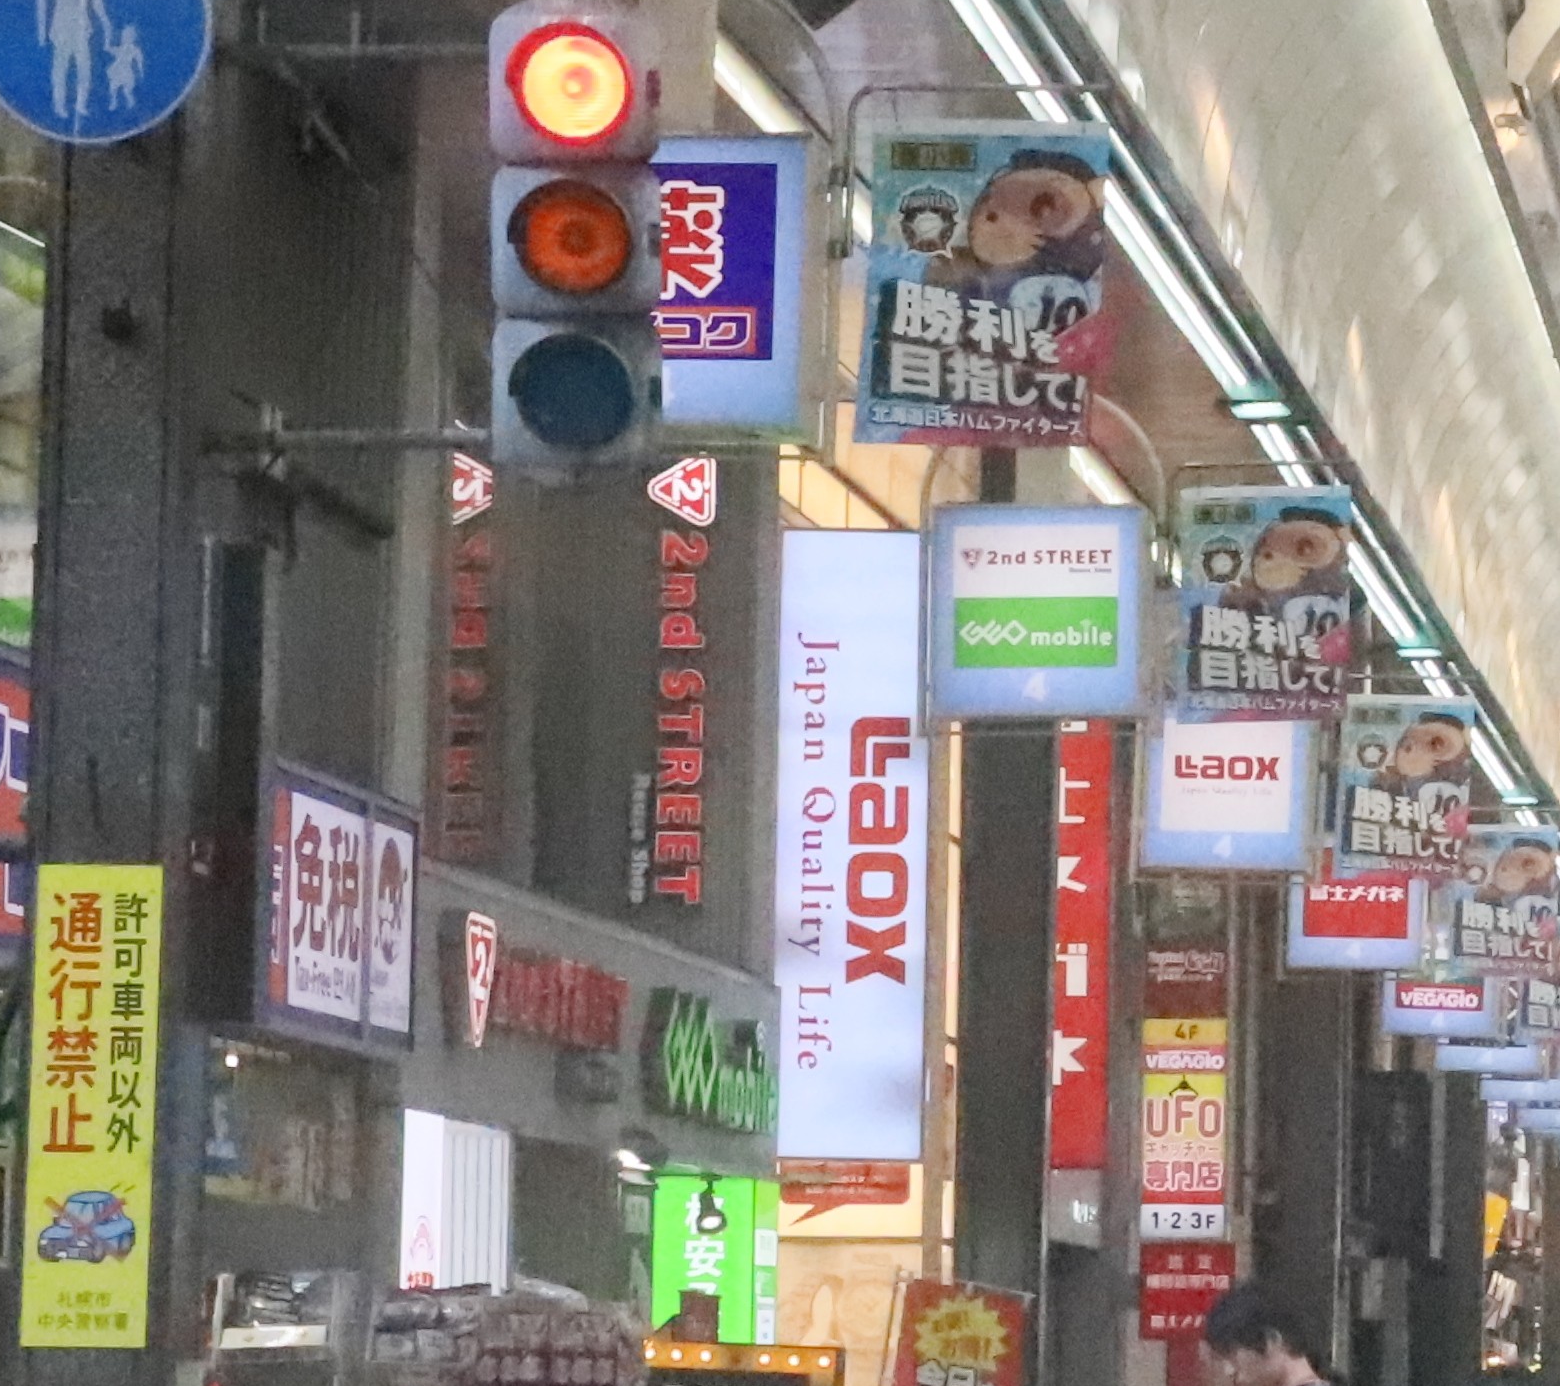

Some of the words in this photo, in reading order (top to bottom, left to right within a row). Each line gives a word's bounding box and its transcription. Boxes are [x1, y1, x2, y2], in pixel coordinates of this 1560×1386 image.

[892, 281, 1060, 364] 勝利を
[889, 344, 1087, 413] 目指して!
[660, 529, 709, 649] 2nd
[986, 547, 1027, 565] 2nd
[1034, 547, 1112, 565] STREET
[1031, 618, 1112, 647] mobile
[1200, 605, 1322, 659] 勝利を
[792, 631, 840, 763] Japan
[1200, 652, 1342, 694] 目指して!
[654, 667, 705, 904] STREET
[791, 785, 838, 958] Quality
[1350, 823, 1462, 859] 目指して!
[293, 812, 360, 962] 免税
[41, 892, 104, 1155] 通行禁止
[106, 893, 149, 1155] 許可車両以外
[795, 983, 833, 1072] Life
[1400, 988, 1481, 1009] VEGAGIO
[1146, 1053, 1225, 1070] VEGAGIO
[1146, 1097, 1223, 1138] UFO
[1145, 1161, 1224, 1190] 専門店
